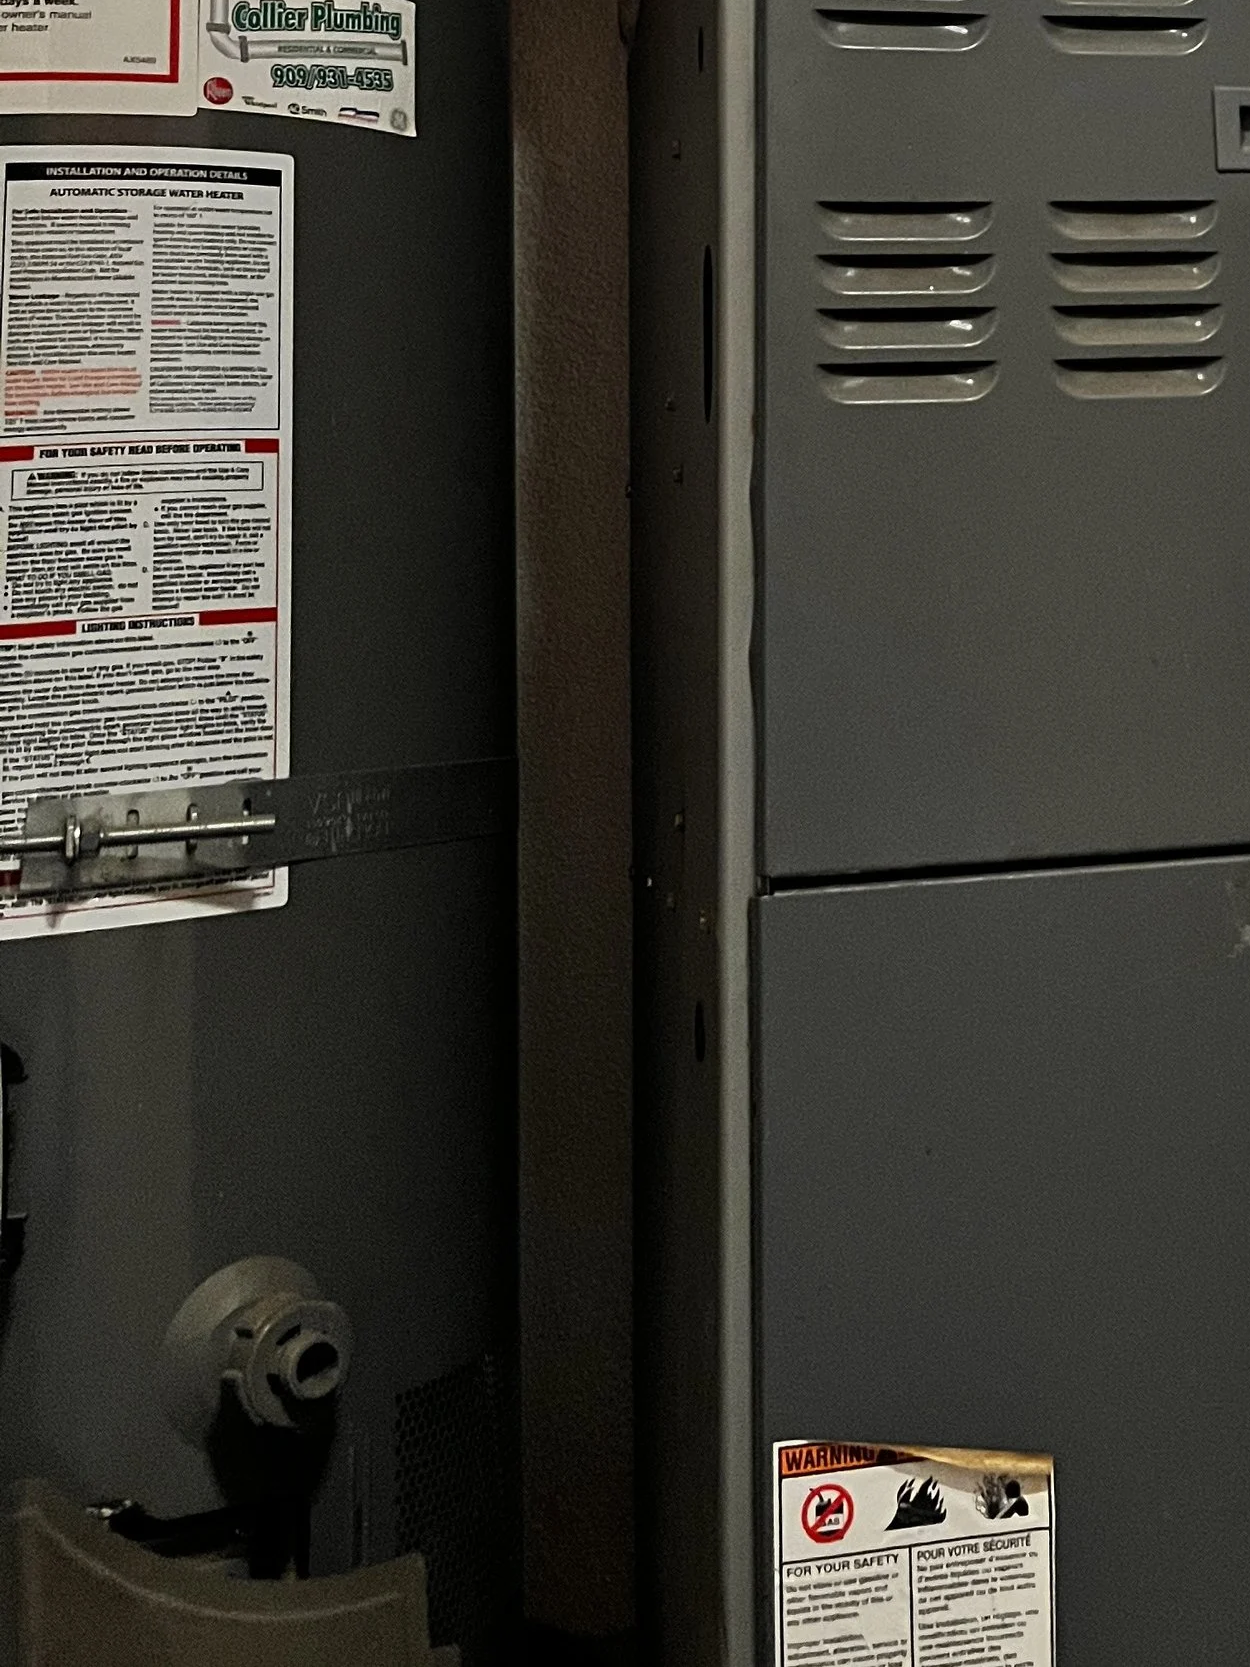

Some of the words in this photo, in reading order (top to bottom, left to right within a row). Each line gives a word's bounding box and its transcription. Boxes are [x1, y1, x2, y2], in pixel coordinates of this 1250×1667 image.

[49, 10, 92, 20] manual
[310, 0, 402, 41] Plumbing
[11, 22, 49, 32] heater
[270, 63, 395, 92] 909/931-4535
[46, 167, 122, 176] INSTALLATION
[123, 167, 148, 176] AND
[149, 168, 208, 178] OPERATION
[209, 170, 248, 180] DETAILS
[49, 188, 116, 197] AUTOMATIC
[117, 188, 167, 197] STORAGE
[168, 189, 204, 199] WATER
[205, 191, 244, 200] HEATER
[89, 445, 126, 457] SAFETY
[127, 444, 153, 455] READ
[155, 444, 191, 454] BEFORE
[192, 443, 242, 453] OPERATING
[81, 621, 126, 634] LIGHTING
[128, 616, 195, 630] INSTRUCTIONS
[917, 1547, 946, 1561] POUR
[947, 1542, 980, 1557] VOTRE
[983, 1533, 1032, 1552] SÉCURITÉ
[787, 1566, 812, 1578] FOR
[815, 1560, 851, 1574] YOUR
[853, 1553, 900, 1569] SAFETY
